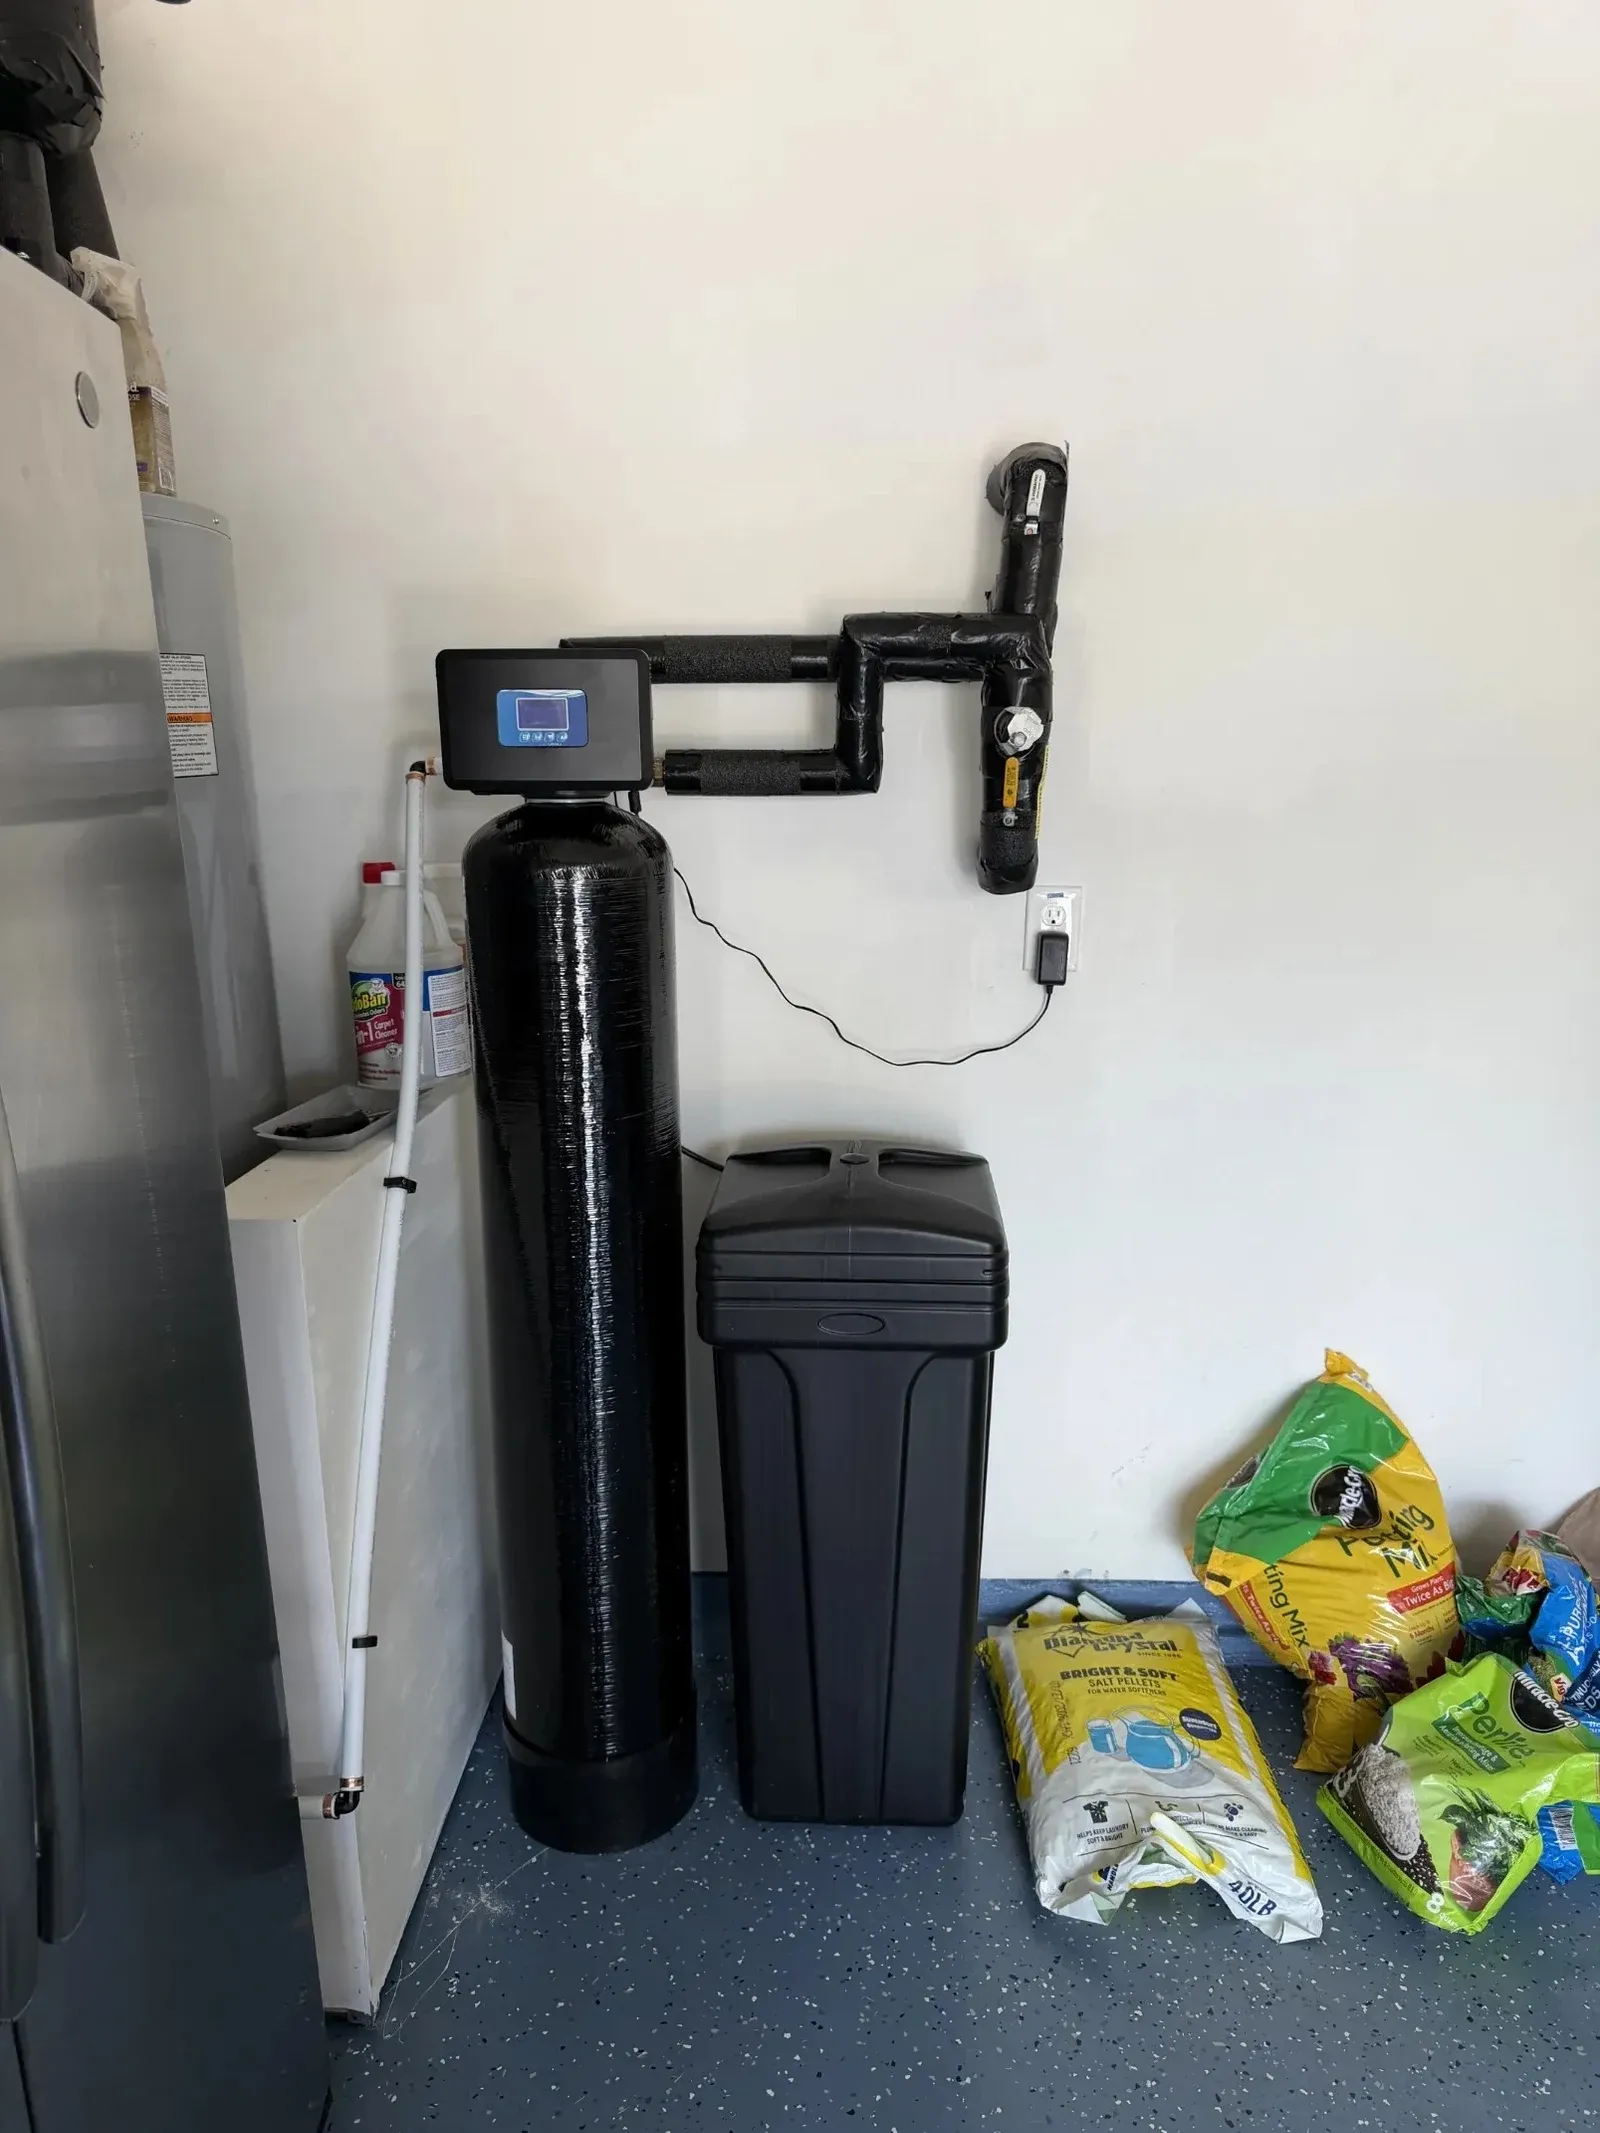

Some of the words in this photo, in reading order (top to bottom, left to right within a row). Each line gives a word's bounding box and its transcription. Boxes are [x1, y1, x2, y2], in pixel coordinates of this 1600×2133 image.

[374, 1018, 395, 1031] Carpet
[374, 1028, 398, 1040] Cleaner
[1403, 1591, 1432, 1607] Twice
[1432, 1585, 1444, 1596] As
[1282, 1608, 1310, 1648] Mix
[1043, 1631, 1145, 1651] Diamond
[1092, 1638, 1179, 1653] Crystal
[1060, 1666, 1121, 1681] BRIGHT
[1122, 1666, 1137, 1677] &
[1137, 1667, 1177, 1682] SOFT
[1088, 1677, 1116, 1688] SALT
[1118, 1678, 1162, 1689] PELLETS
[1087, 1688, 1101, 1696] FOR
[1102, 1687, 1127, 1695] WATER
[1457, 1692, 1536, 1760] Perlite
[1076, 1829, 1093, 1840] HELPS
[1093, 1828, 1106, 1836] KEEP
[1106, 1822, 1130, 1834] LAUNDRY
[1241, 1826, 1268, 1834] CLEANING
[1086, 1835, 1101, 1845] SOFT
[1104, 1832, 1124, 1842] BRIGHT
[1426, 1891, 1445, 1914] 8
